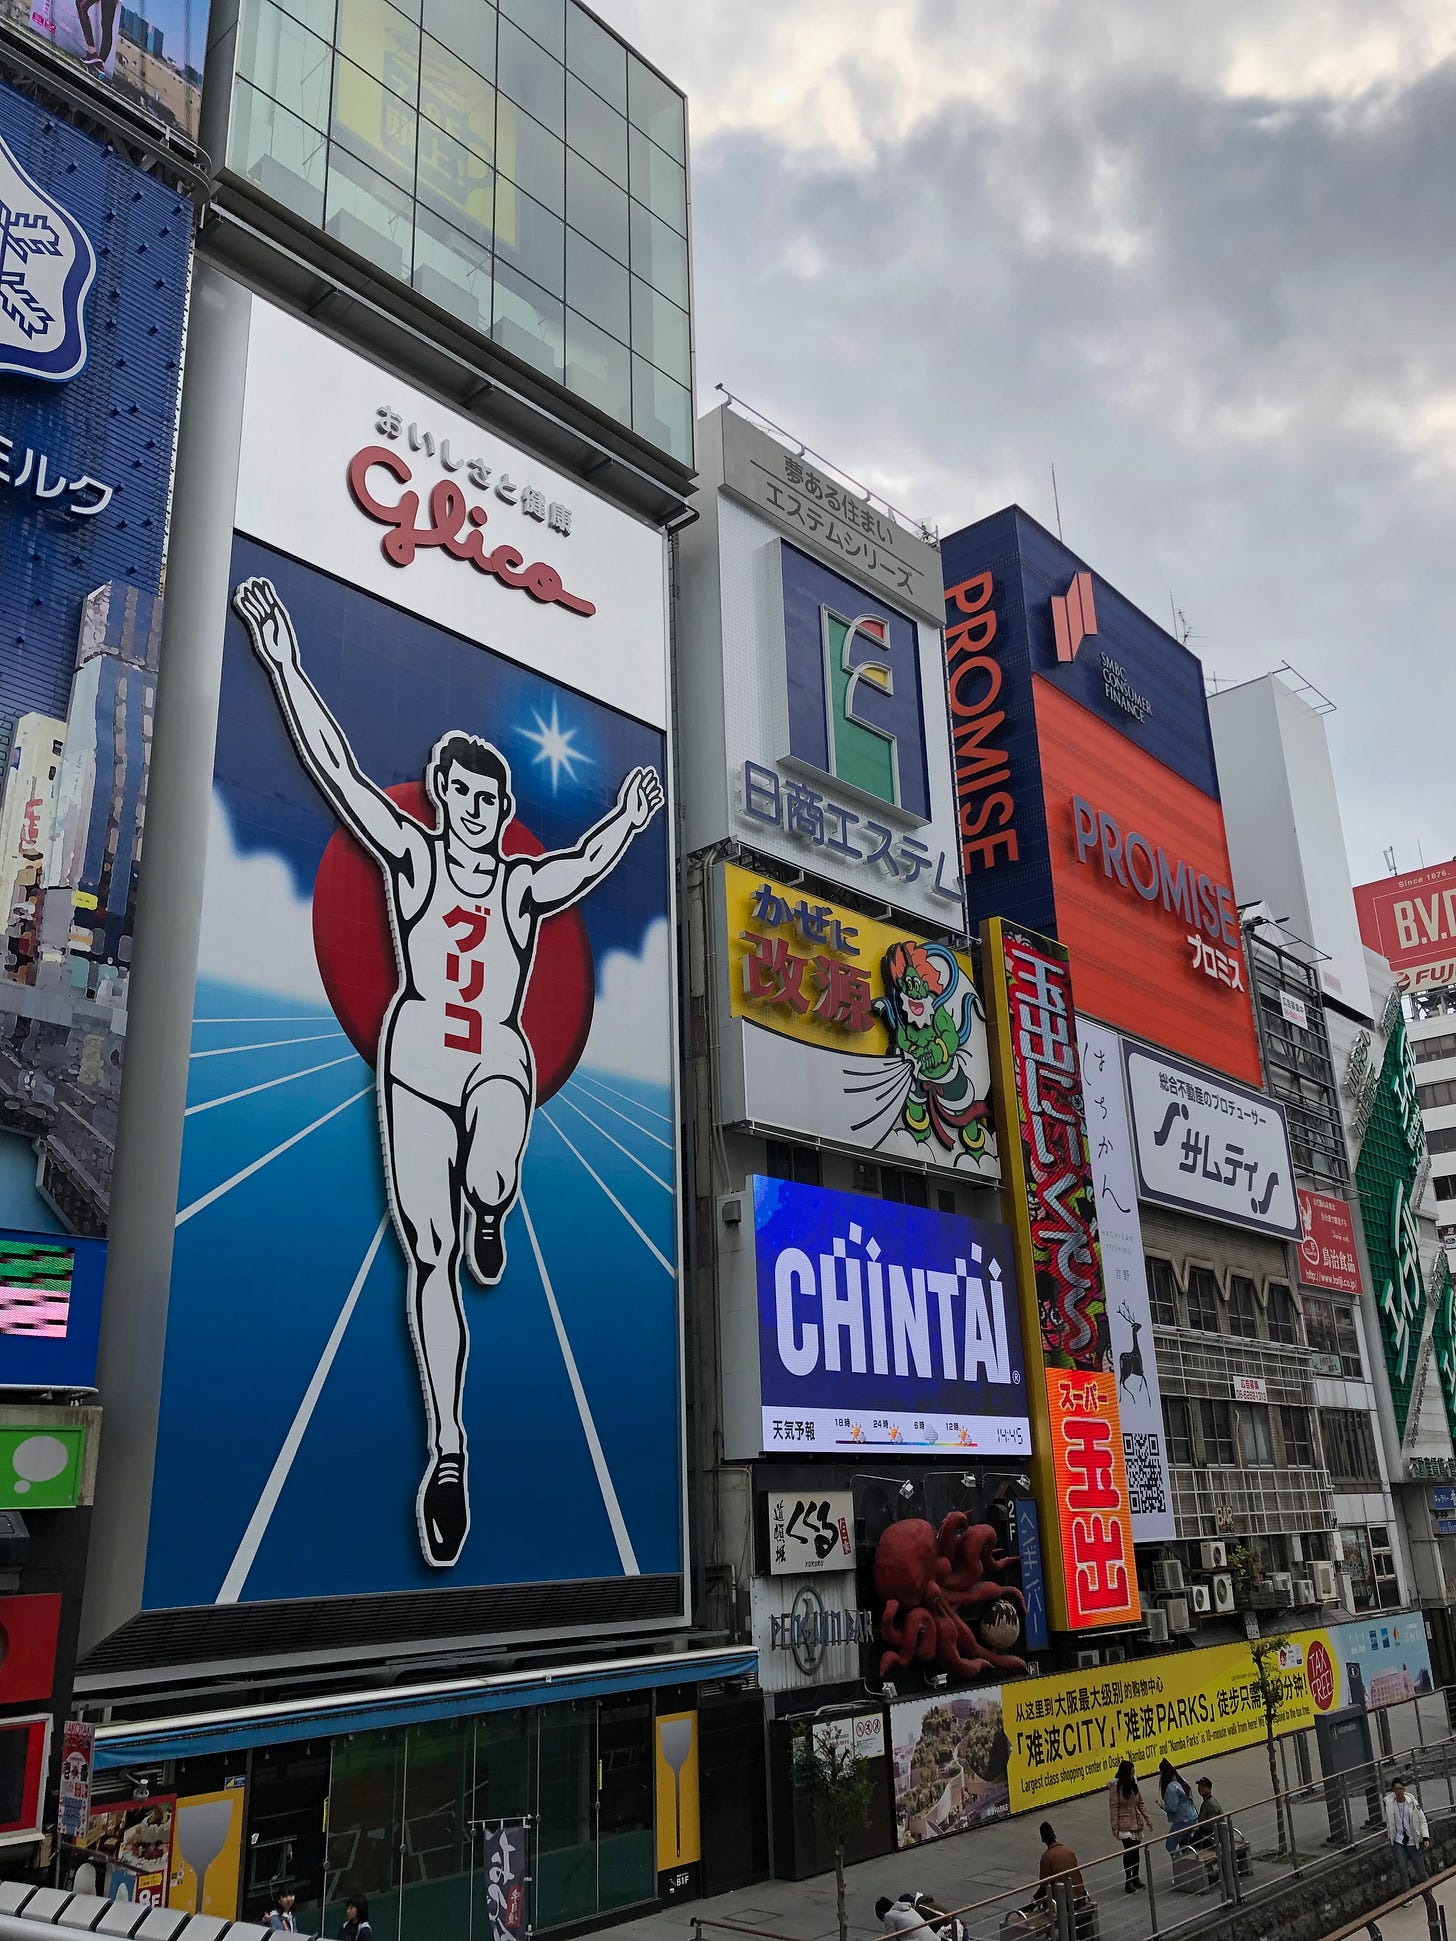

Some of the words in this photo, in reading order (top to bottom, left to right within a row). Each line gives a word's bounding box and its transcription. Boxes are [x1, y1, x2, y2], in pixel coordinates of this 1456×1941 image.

[375, 405, 572, 537] おいしさと健康
[784, 455, 893, 544] 夢ある住まい
[346, 445, 596, 618] Glico
[766, 481, 913, 595] エステムシリーズ
[1101, 652, 1127, 682] SMBC
[1103, 668, 1153, 717] CONSUMER
[943, 570, 1019, 875] PROMISE
[1105, 682, 1145, 724] FINANCE
[744, 760, 967, 903] 日商エステム
[1073, 794, 1239, 949] PROMISE
[1398, 877, 1424, 889] Since
[751, 883, 861, 956] かぜに
[441, 904, 491, 1055] グリコ
[740, 930, 876, 1032] 改源
[1187, 933, 1245, 993] プロミス
[1083, 1041, 1131, 1214] はちかん
[1158, 1071, 1267, 1126] 総合不動産のプロデューサー
[1179, 1127, 1259, 1192] サムティ
[772, 1419, 815, 1441] 天気予報
[834, 1418, 851, 1428] 18時
[873, 1419, 889, 1429] 24時
[914, 1421, 925, 1430] 6時
[945, 1422, 959, 1432] 12時
[1059, 1380, 1108, 1412] スーパー
[786, 1500, 839, 1560] くくる
[1061, 1417, 1131, 1615] 玉出
[1020, 1511, 1043, 1634] ペンギンバー
[845, 1608, 874, 1646] BAR
[1309, 1647, 1327, 1679] TAX
[1020, 1775, 1044, 1794] Largest
[1044, 1772, 1060, 1787] class
[1060, 1765, 1084, 1783] shopping
[1085, 1760, 1102, 1776] center
[1102, 1757, 1109, 1771] in
[1159, 1743, 1168, 1755] and
[1201, 1733, 1206, 1744] is
[1205, 1725, 1227, 1742] 10-minute
[1227, 1722, 1238, 1737] walk
[1237, 1722, 1248, 1734] from
[676, 1875, 689, 1887] B1F
